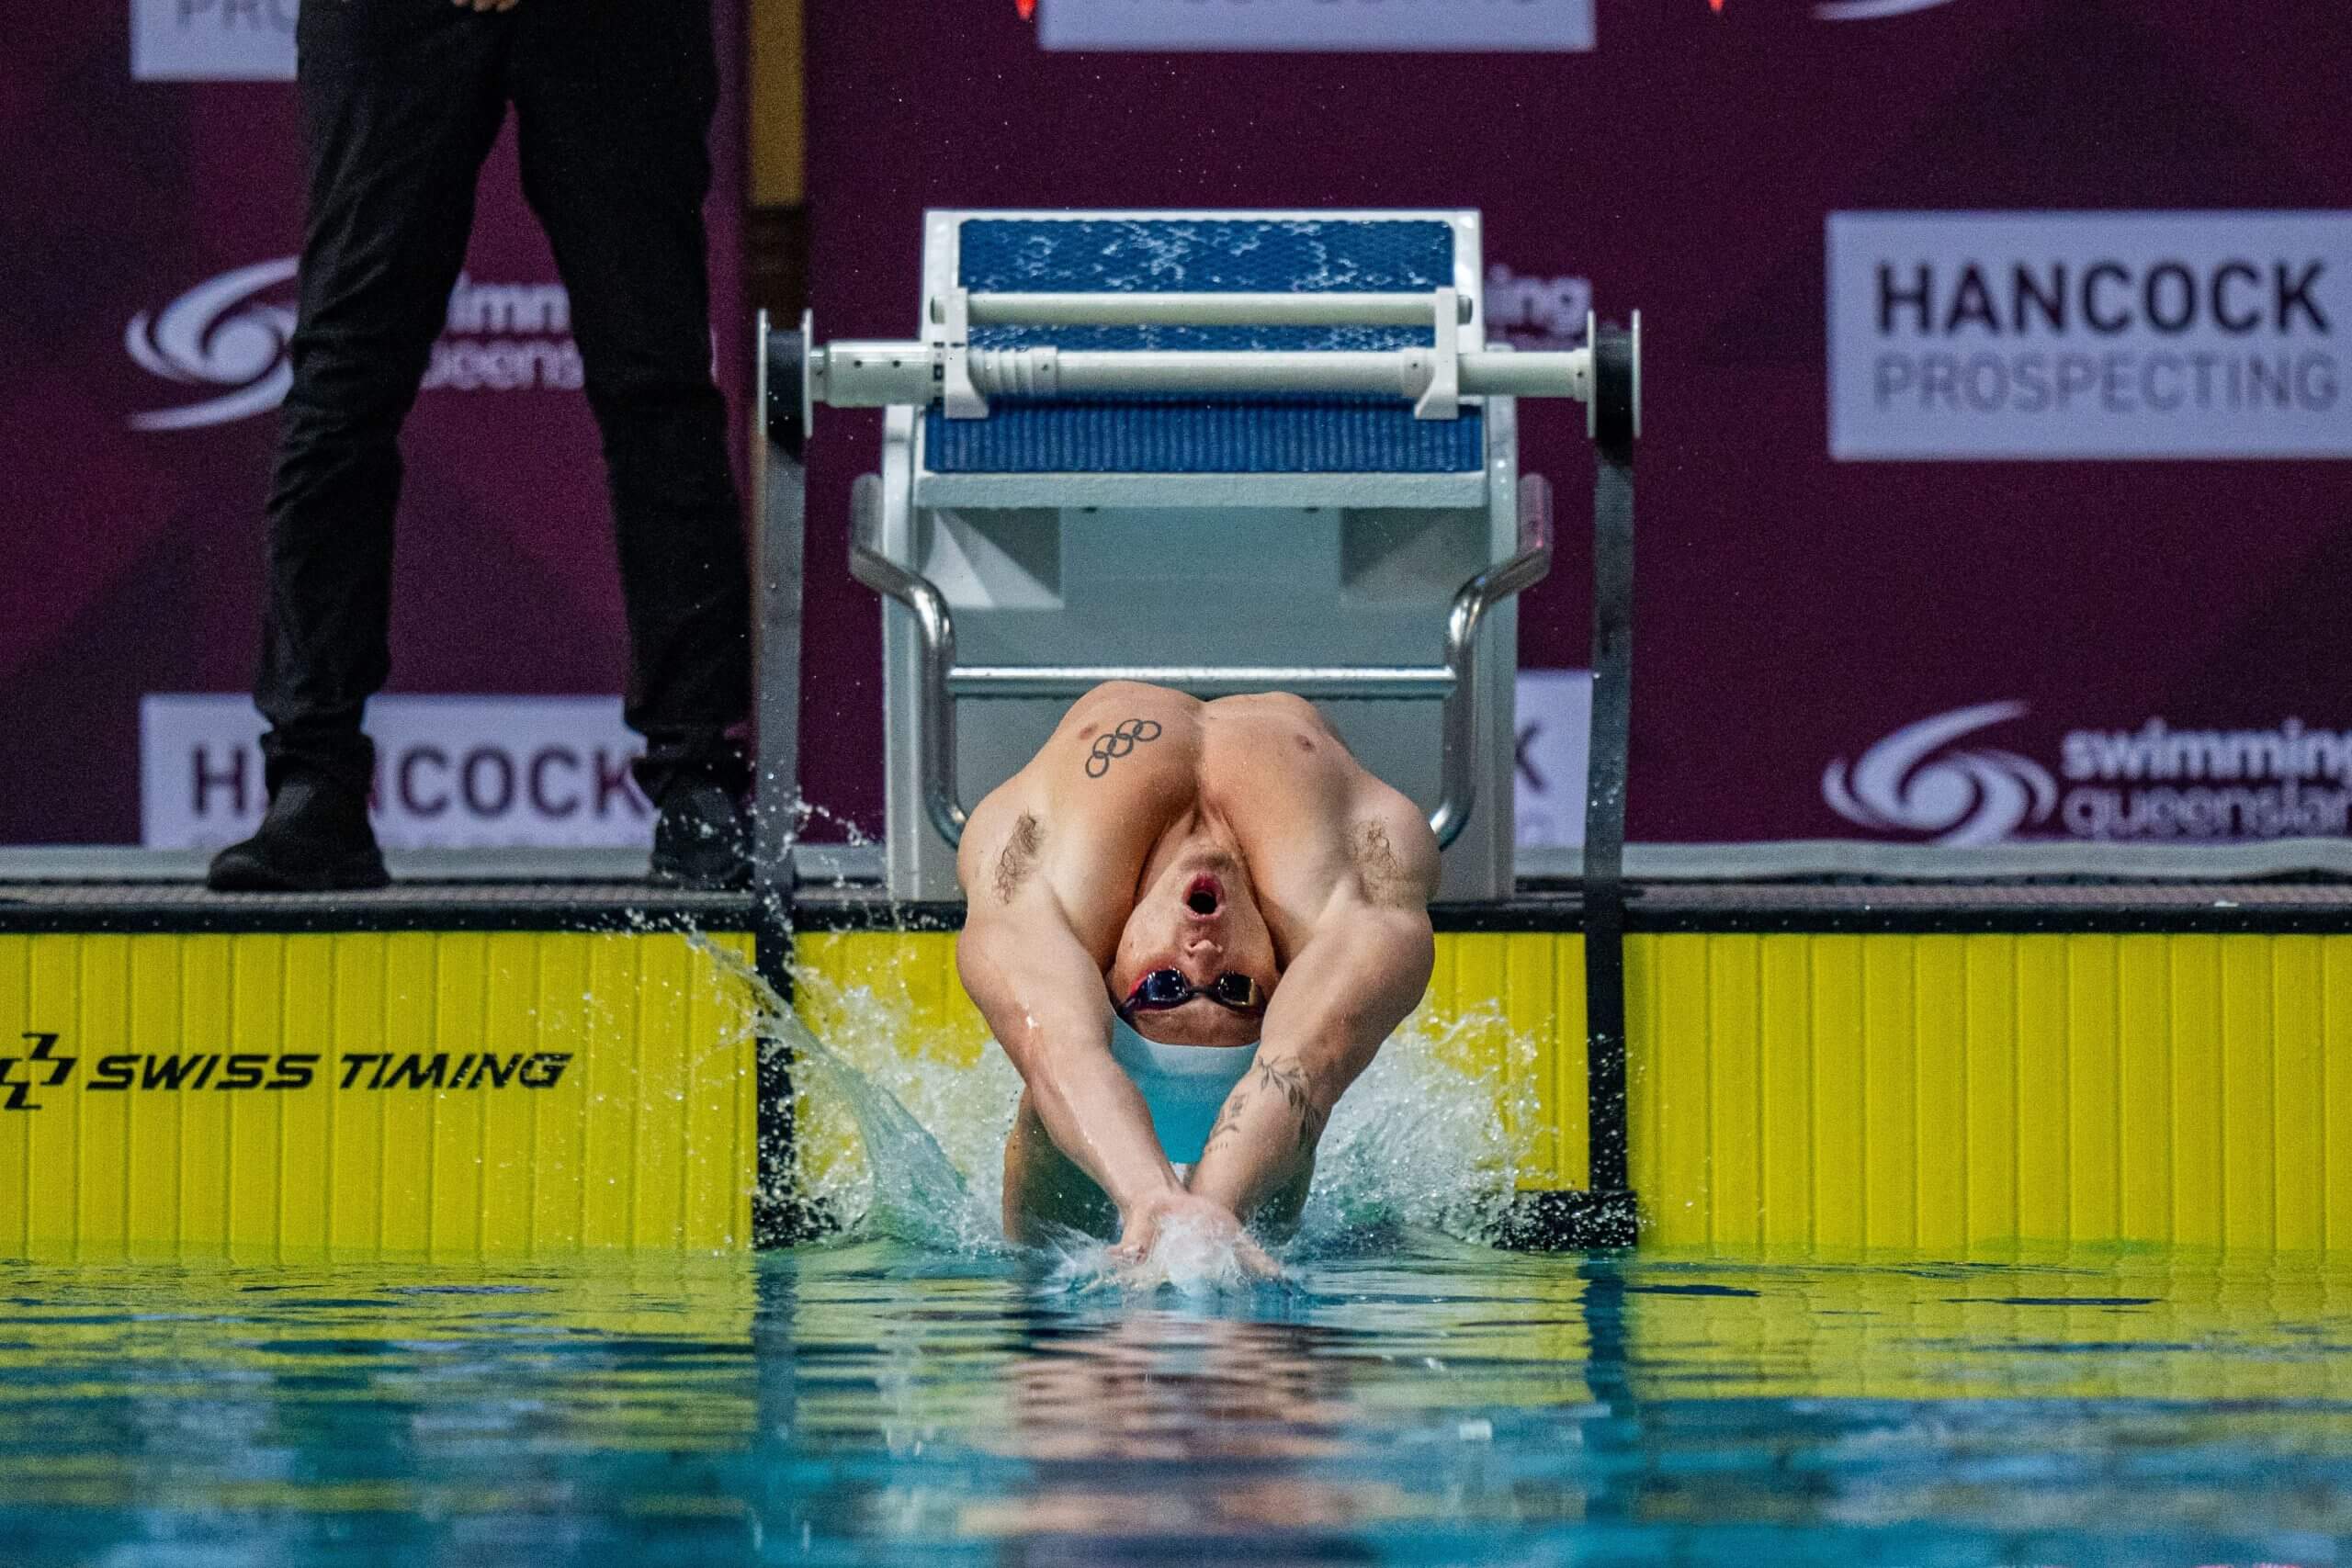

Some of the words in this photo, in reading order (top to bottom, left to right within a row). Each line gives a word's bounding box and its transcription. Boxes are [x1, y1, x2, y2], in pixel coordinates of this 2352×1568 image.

[1873, 260, 2330, 335] HANCOCK
[1872, 349, 2340, 412] PROSPECTING
[2061, 716, 2352, 781] swimmin
[192, 745, 650, 818] HCOCK
[86, 1054, 321, 1090] SWISS
[339, 1053, 574, 1090] TIMING
